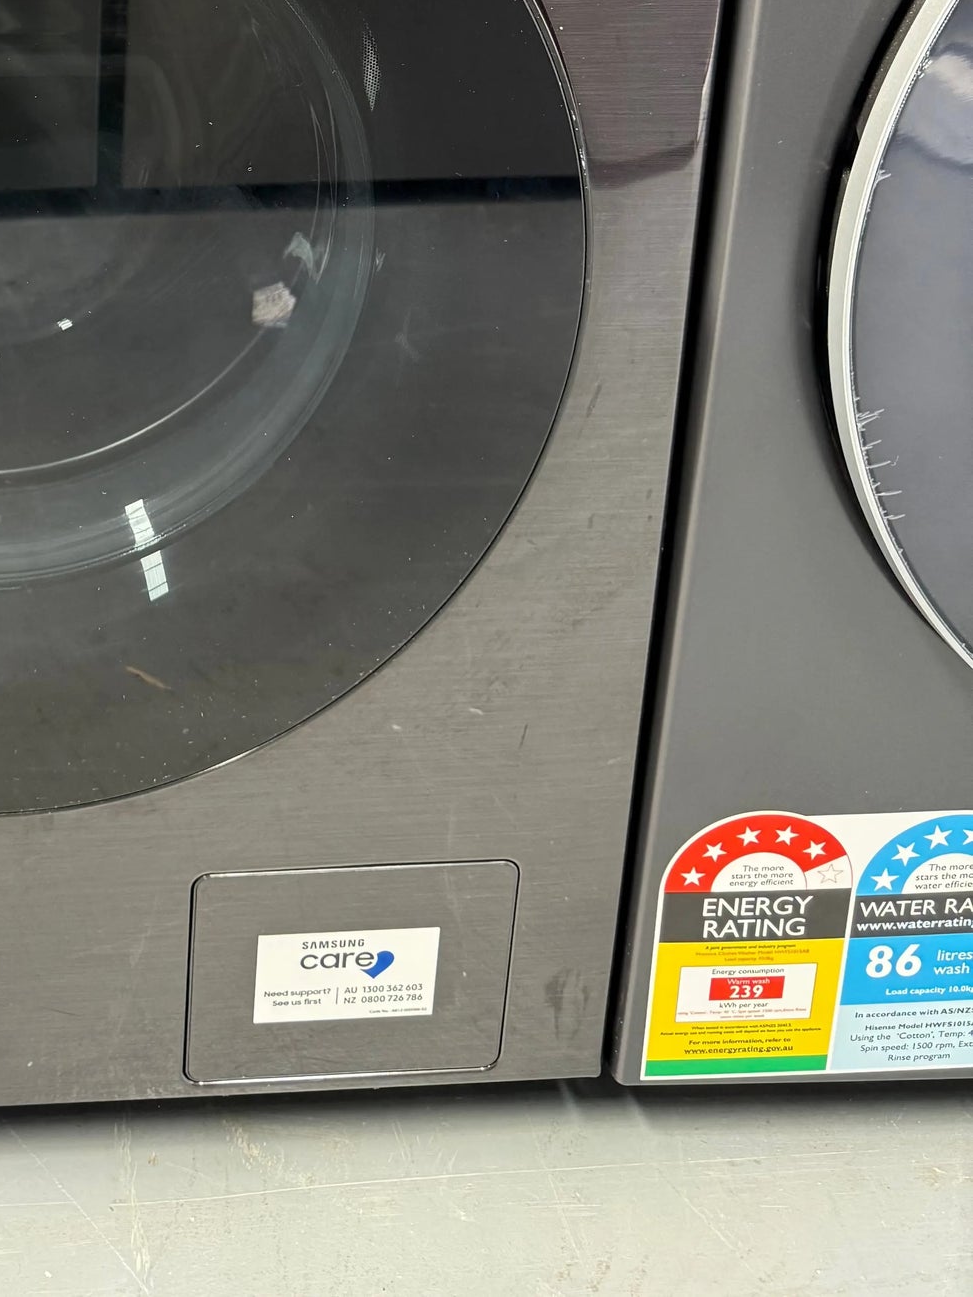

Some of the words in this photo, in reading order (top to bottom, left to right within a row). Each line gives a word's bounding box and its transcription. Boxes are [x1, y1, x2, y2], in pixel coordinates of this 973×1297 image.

[702, 895, 814, 916] ENERGY
[860, 900, 936, 917] WATER
[945, 898, 973, 914] RA
[703, 918, 806, 939] RATING
[302, 939, 365, 949] SAMSUNG
[300, 951, 375, 970] care
[866, 943, 922, 978] 86
[937, 950, 973, 961] litres
[738, 967, 784, 975] consumption
[934, 963, 970, 974] wash
[291, 988, 331, 997] support?
[363, 985, 384, 993] 1300
[729, 985, 764, 998] 239
[910, 987, 946, 995] capacity
[684, 1045, 793, 1055] www.energyrating.gov.au
